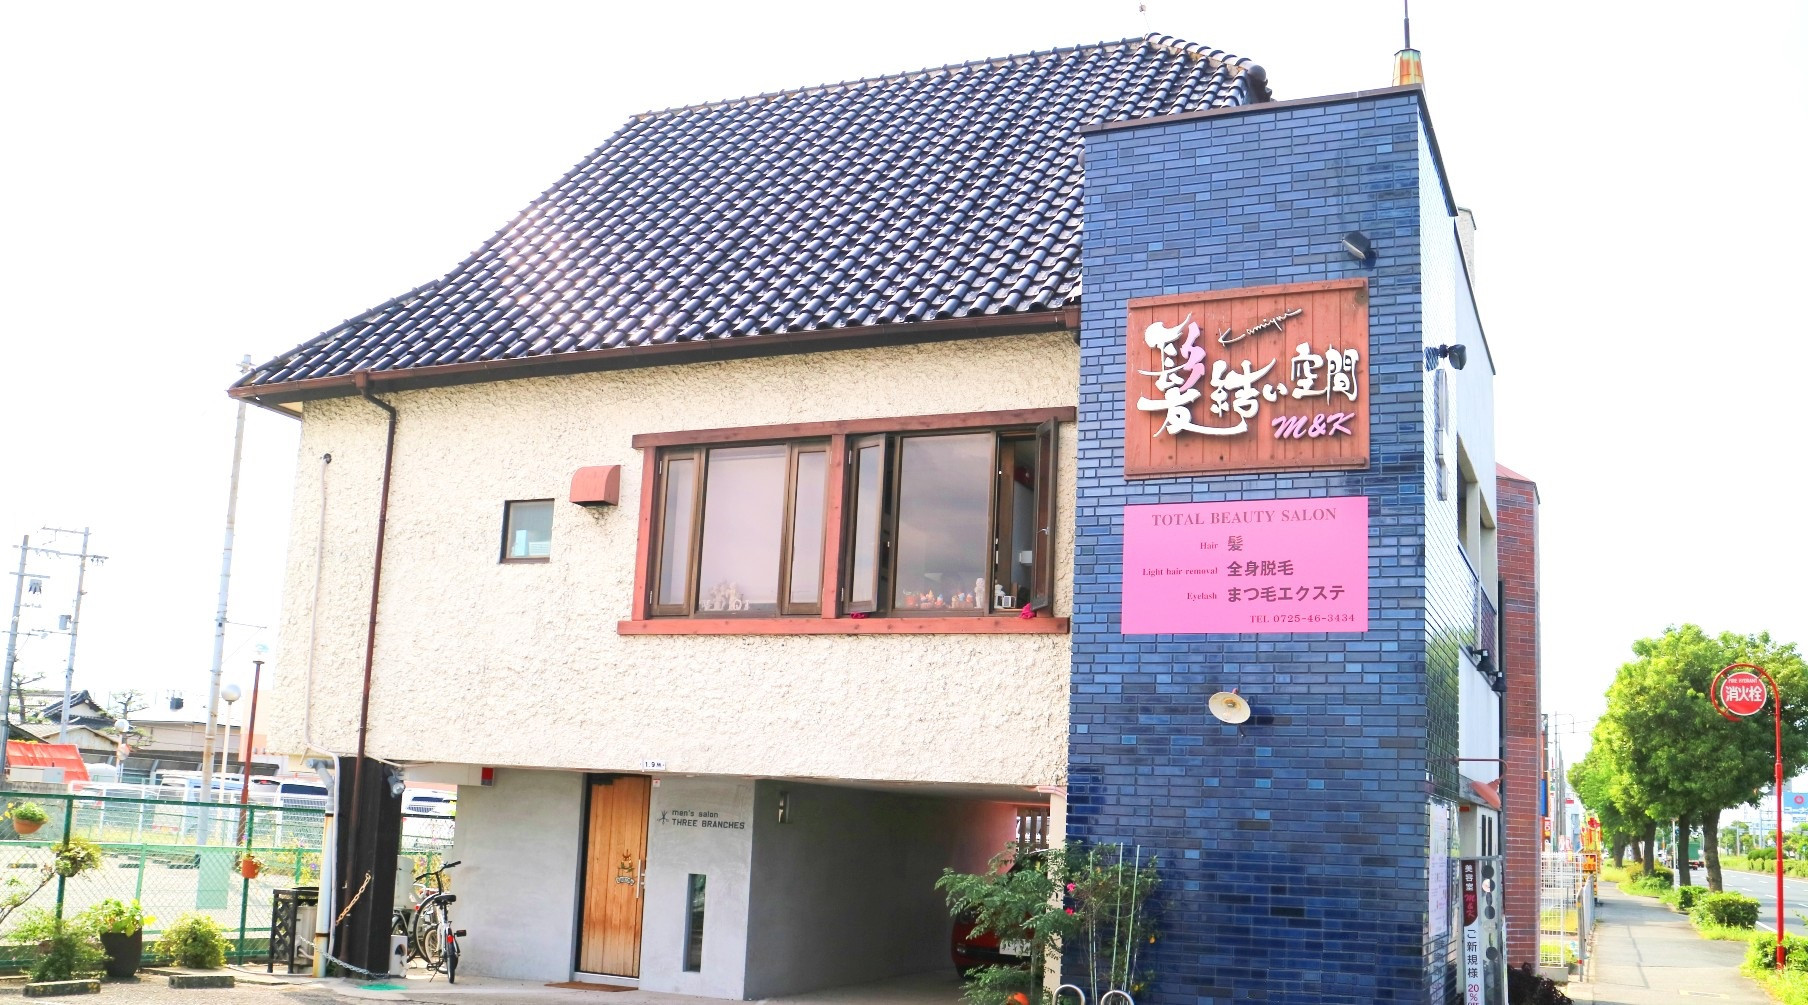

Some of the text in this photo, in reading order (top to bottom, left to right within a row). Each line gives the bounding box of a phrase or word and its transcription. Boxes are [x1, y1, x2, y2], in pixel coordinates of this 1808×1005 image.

[1271, 412, 1356, 440] M&K
[1151, 507, 1337, 527] TOTAL BEAUTY SALON
[1200, 535, 1244, 552] Hair 髪
[1142, 568, 1164, 577] Light
[1185, 567, 1218, 575] removal
[1227, 559, 1294, 577] 全身脱毛
[1187, 585, 1345, 602] Eyelash まつ毛エクステ
[1249, 613, 1355, 624] TEL 0725-46-3434
[1725, 685, 1763, 702] 消火栓
[698, 810, 719, 818] salon
[672, 818, 746, 830] THREE BRANCHES
[1464, 864, 1474, 892] 美容室
[1466, 929, 1479, 979] ご新規様
